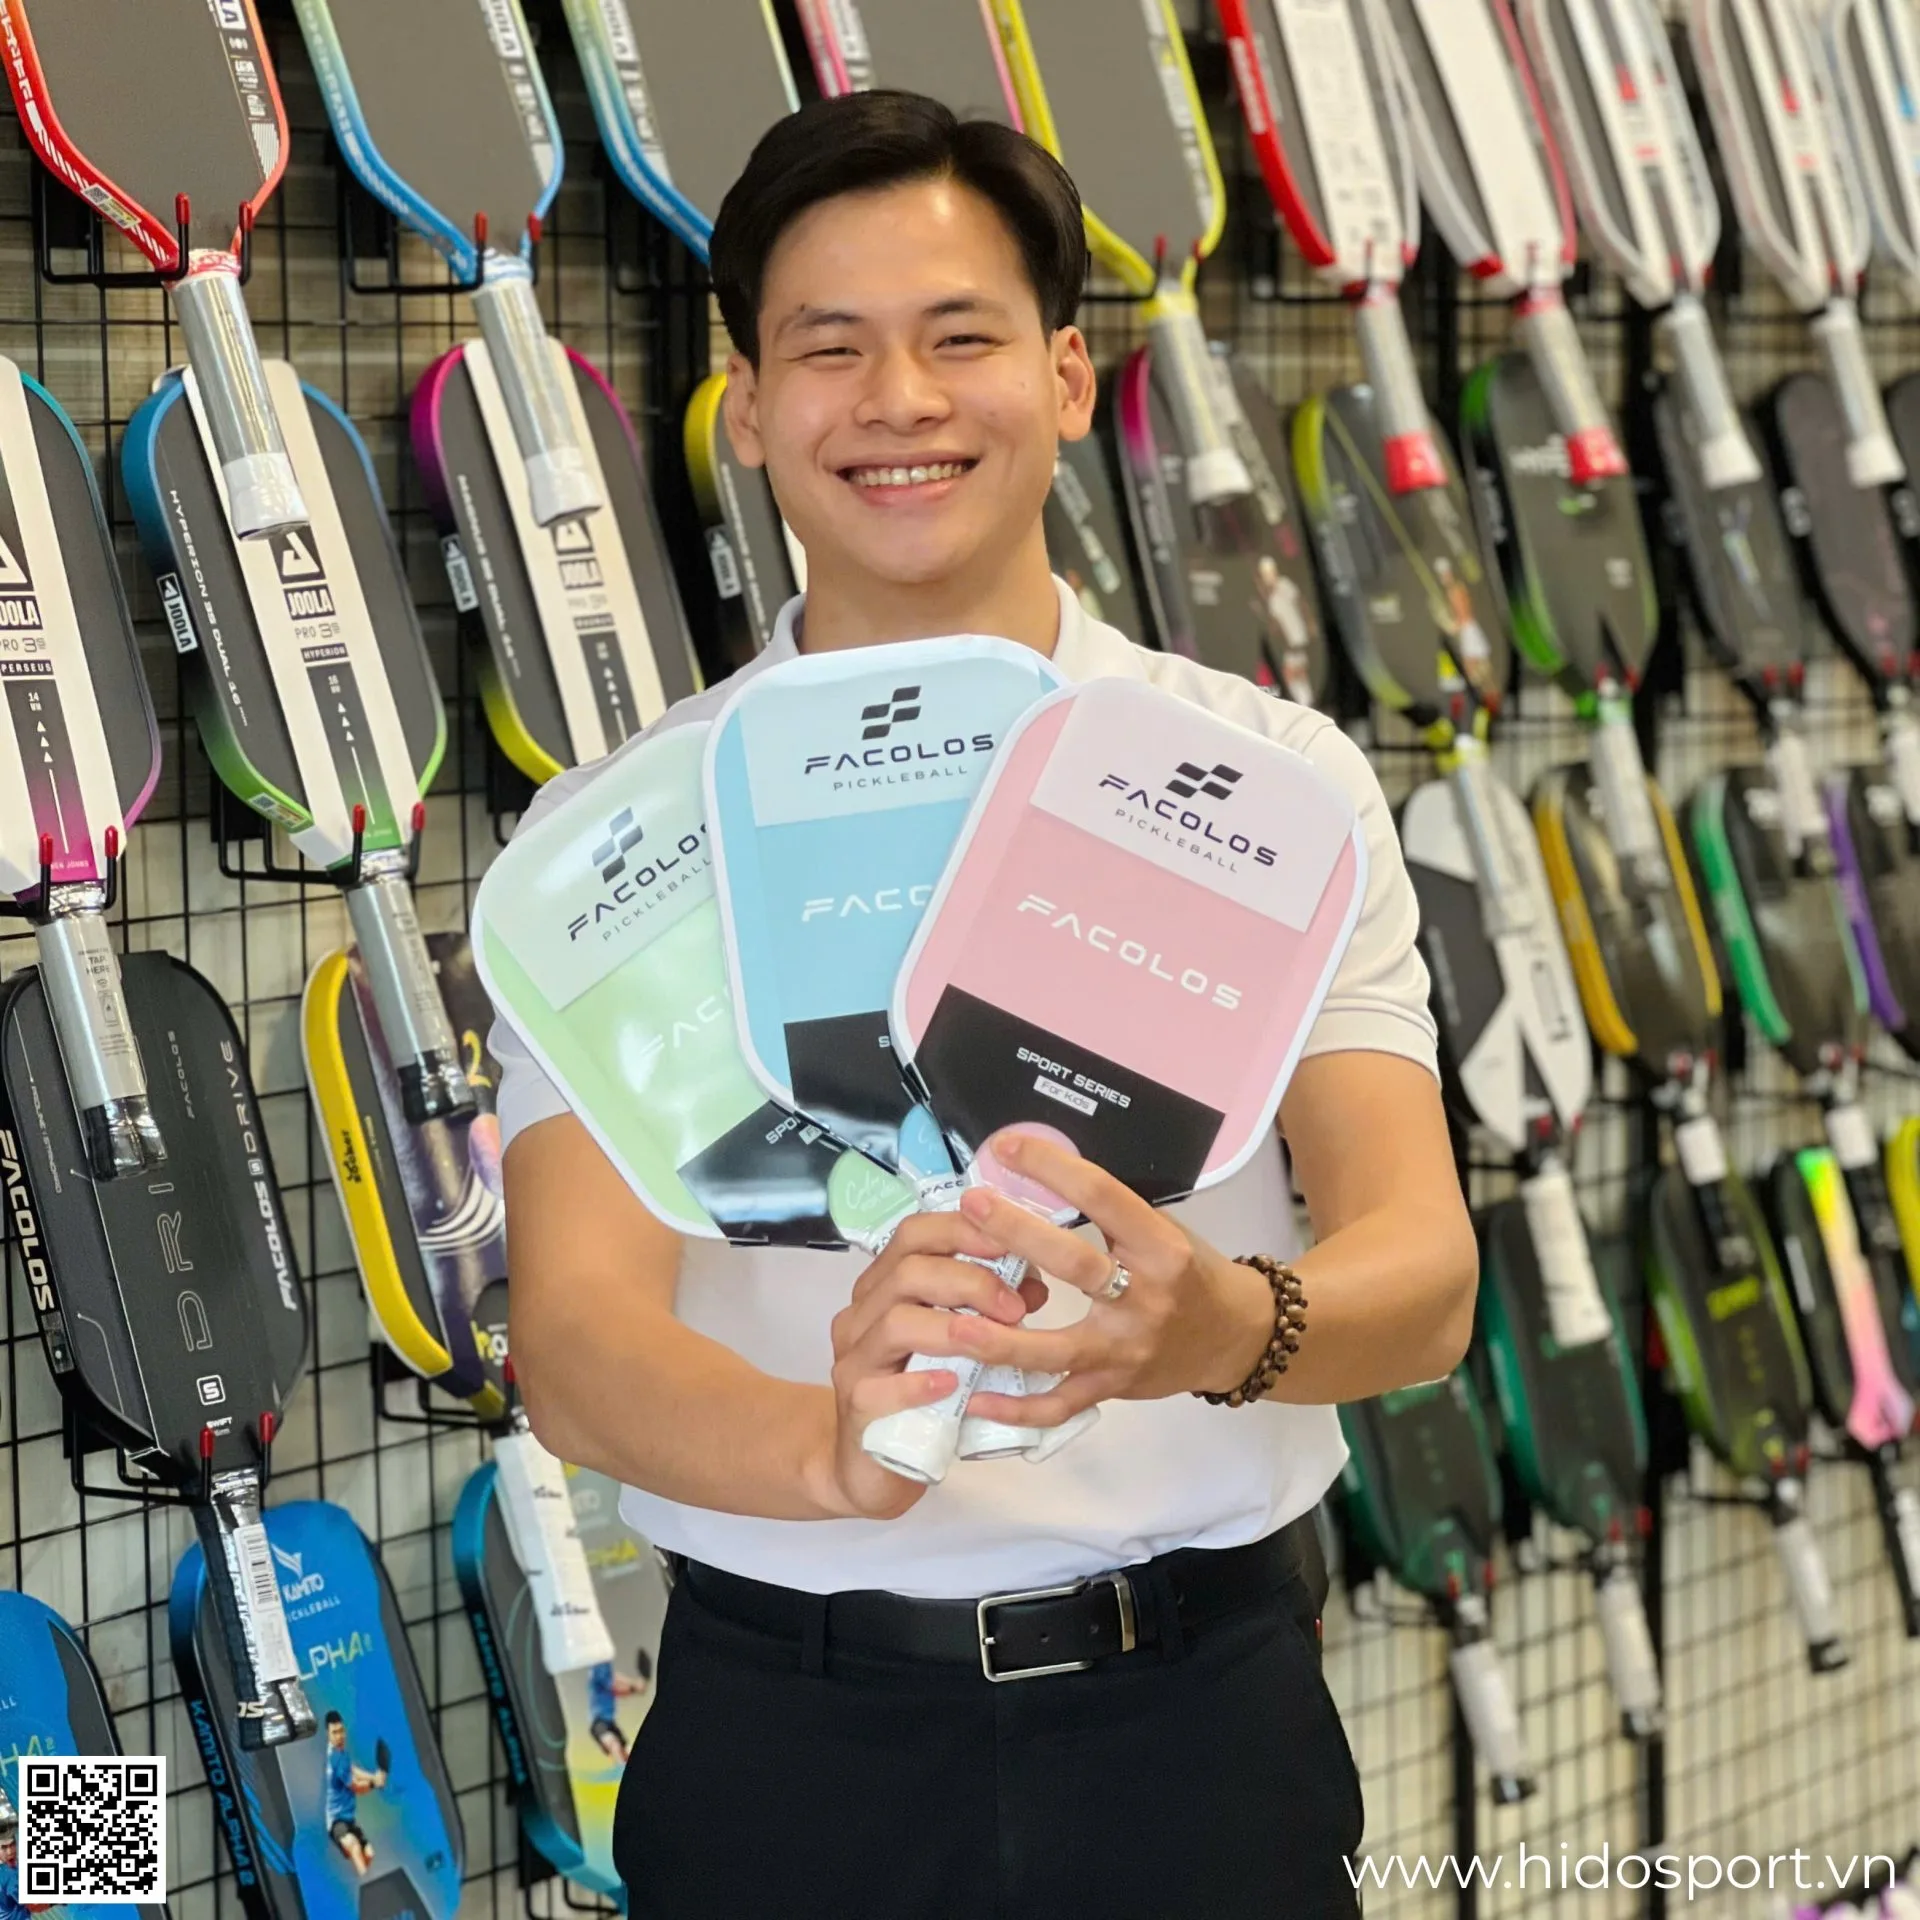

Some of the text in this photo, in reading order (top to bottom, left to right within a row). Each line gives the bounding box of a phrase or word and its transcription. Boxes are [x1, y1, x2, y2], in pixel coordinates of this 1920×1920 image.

[169, 490, 209, 598] HYPERION
[212, 628, 232, 678] DUAL
[288, 588, 333, 616] JOOLA
[0, 639, 19, 652] RO
[167, 601, 193, 649] JOOLA
[294, 626, 316, 640] PRO
[1, 662, 52, 674] PERSEUS
[303, 645, 346, 661] HYPERION
[28, 691, 39, 702] 14
[805, 733, 994, 775] FACOLOS
[834, 766, 967, 791] PICKLEBALL
[1099, 773, 1278, 867] FACOLOS
[1114, 809, 1238, 873] PICKLEBALL
[568, 823, 706, 941] FACOLO
[1016, 894, 1243, 1010] FACOLOS
[167, 1030, 196, 1119] FACOLOS
[220, 1040, 259, 1153] DRIVE
[1016, 1046, 1131, 1108] SPORT SERIES
[1041, 1081, 1063, 1095] For
[0, 1128, 55, 1311] FACOLOS
[254, 1181, 297, 1311] FACOLOS
[282, 1572, 324, 1603] KAMITO
[191, 1700, 226, 1786] KAMITO
[216, 1791, 250, 1866] ALPHA
